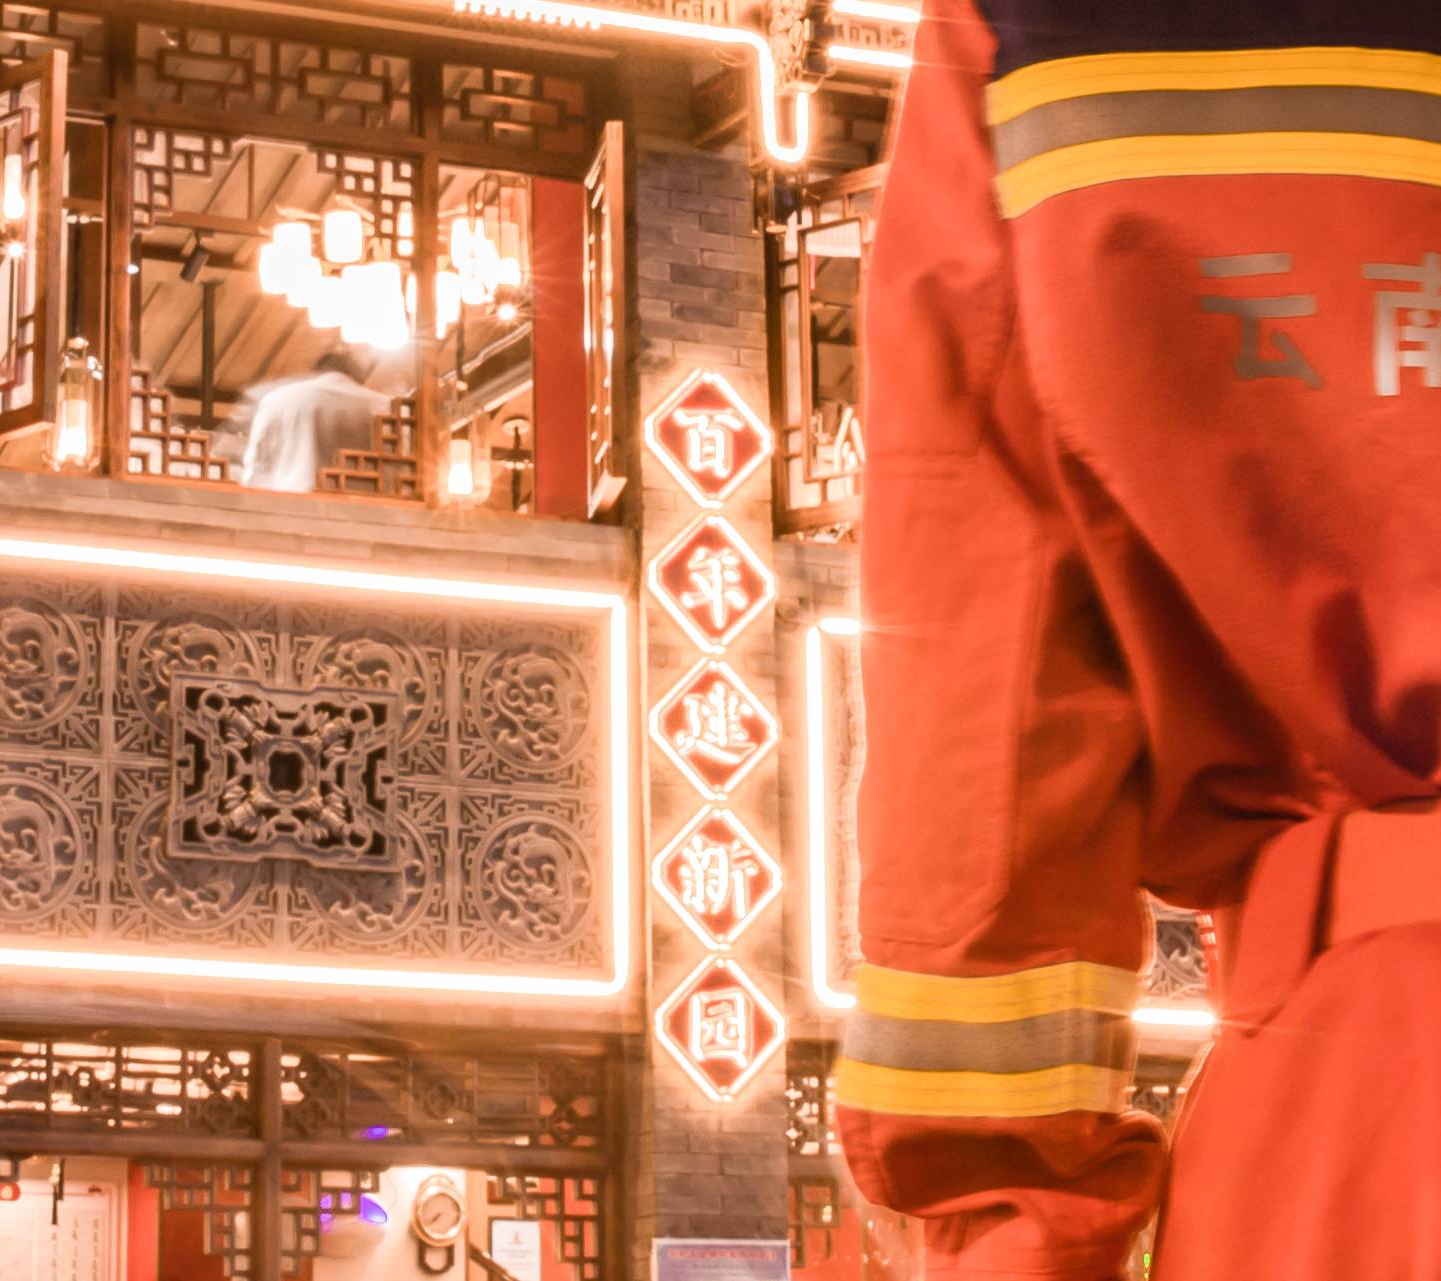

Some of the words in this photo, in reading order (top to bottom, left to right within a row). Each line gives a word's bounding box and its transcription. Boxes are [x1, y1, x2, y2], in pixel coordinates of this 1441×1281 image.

[670, 404, 761, 1067] 百年建新园
